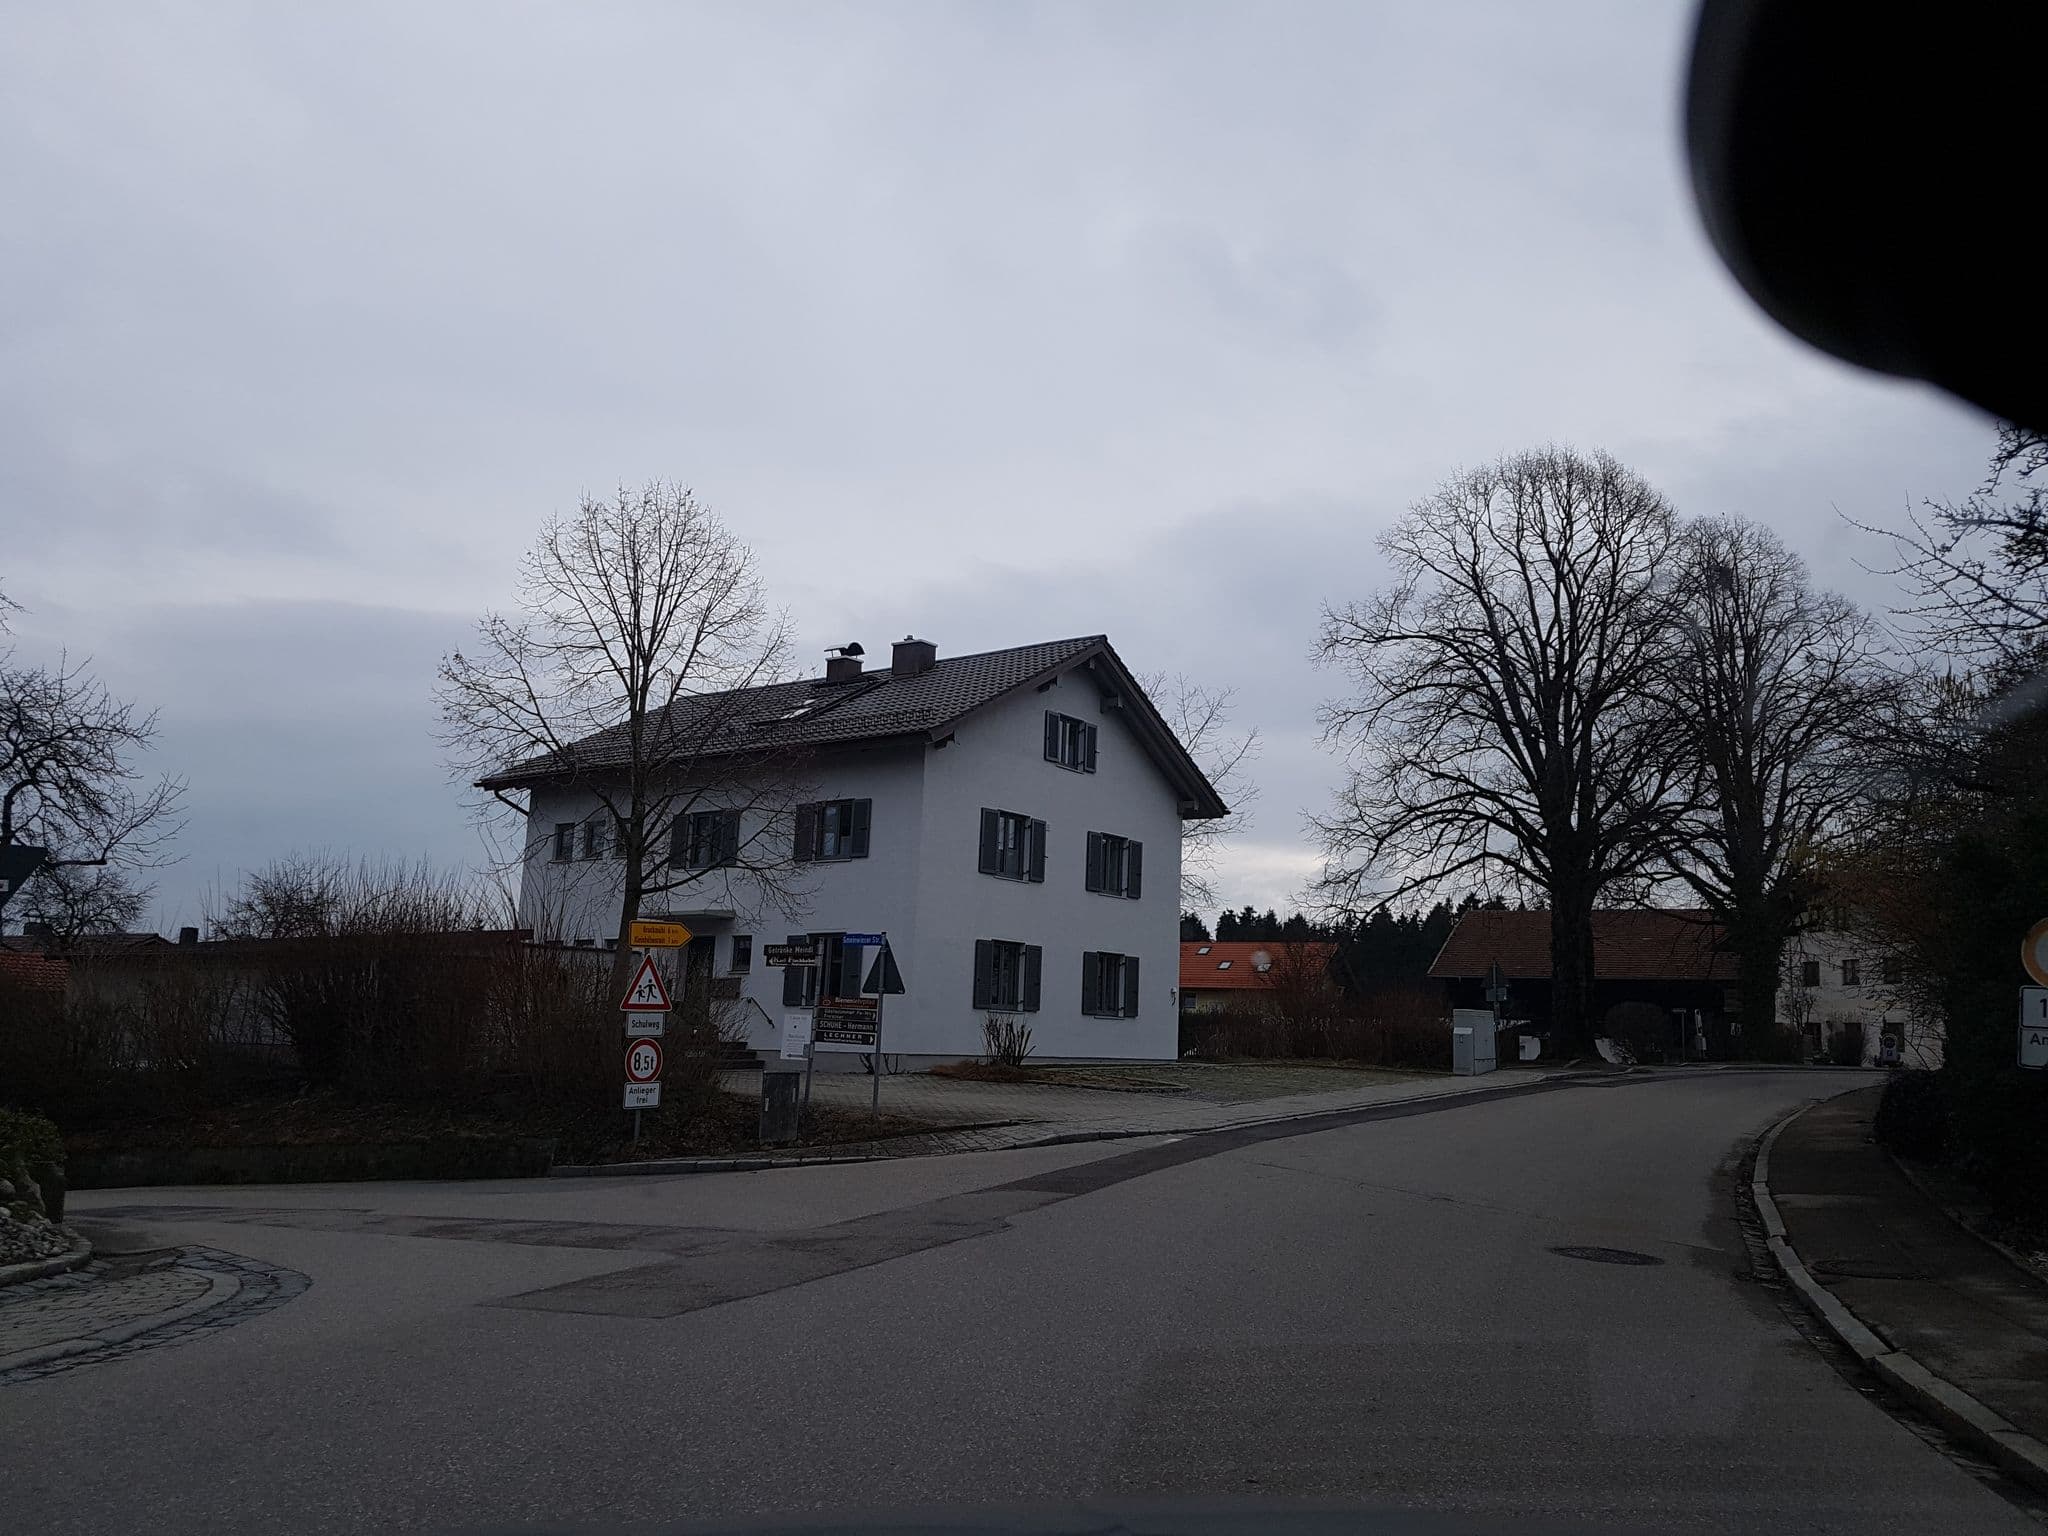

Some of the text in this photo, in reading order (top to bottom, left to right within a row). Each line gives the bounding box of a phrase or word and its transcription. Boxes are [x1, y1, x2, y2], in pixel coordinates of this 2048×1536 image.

[768, 946, 793, 954] Getränke
[631, 1019, 660, 1030] Schulweg
[819, 1020, 842, 1030] SCHUHE
[847, 1021, 874, 1031] Hermann
[823, 1032, 863, 1040] LECHNER
[629, 1086, 656, 1096] Anlieger
[636, 1096, 648, 1104] frei
